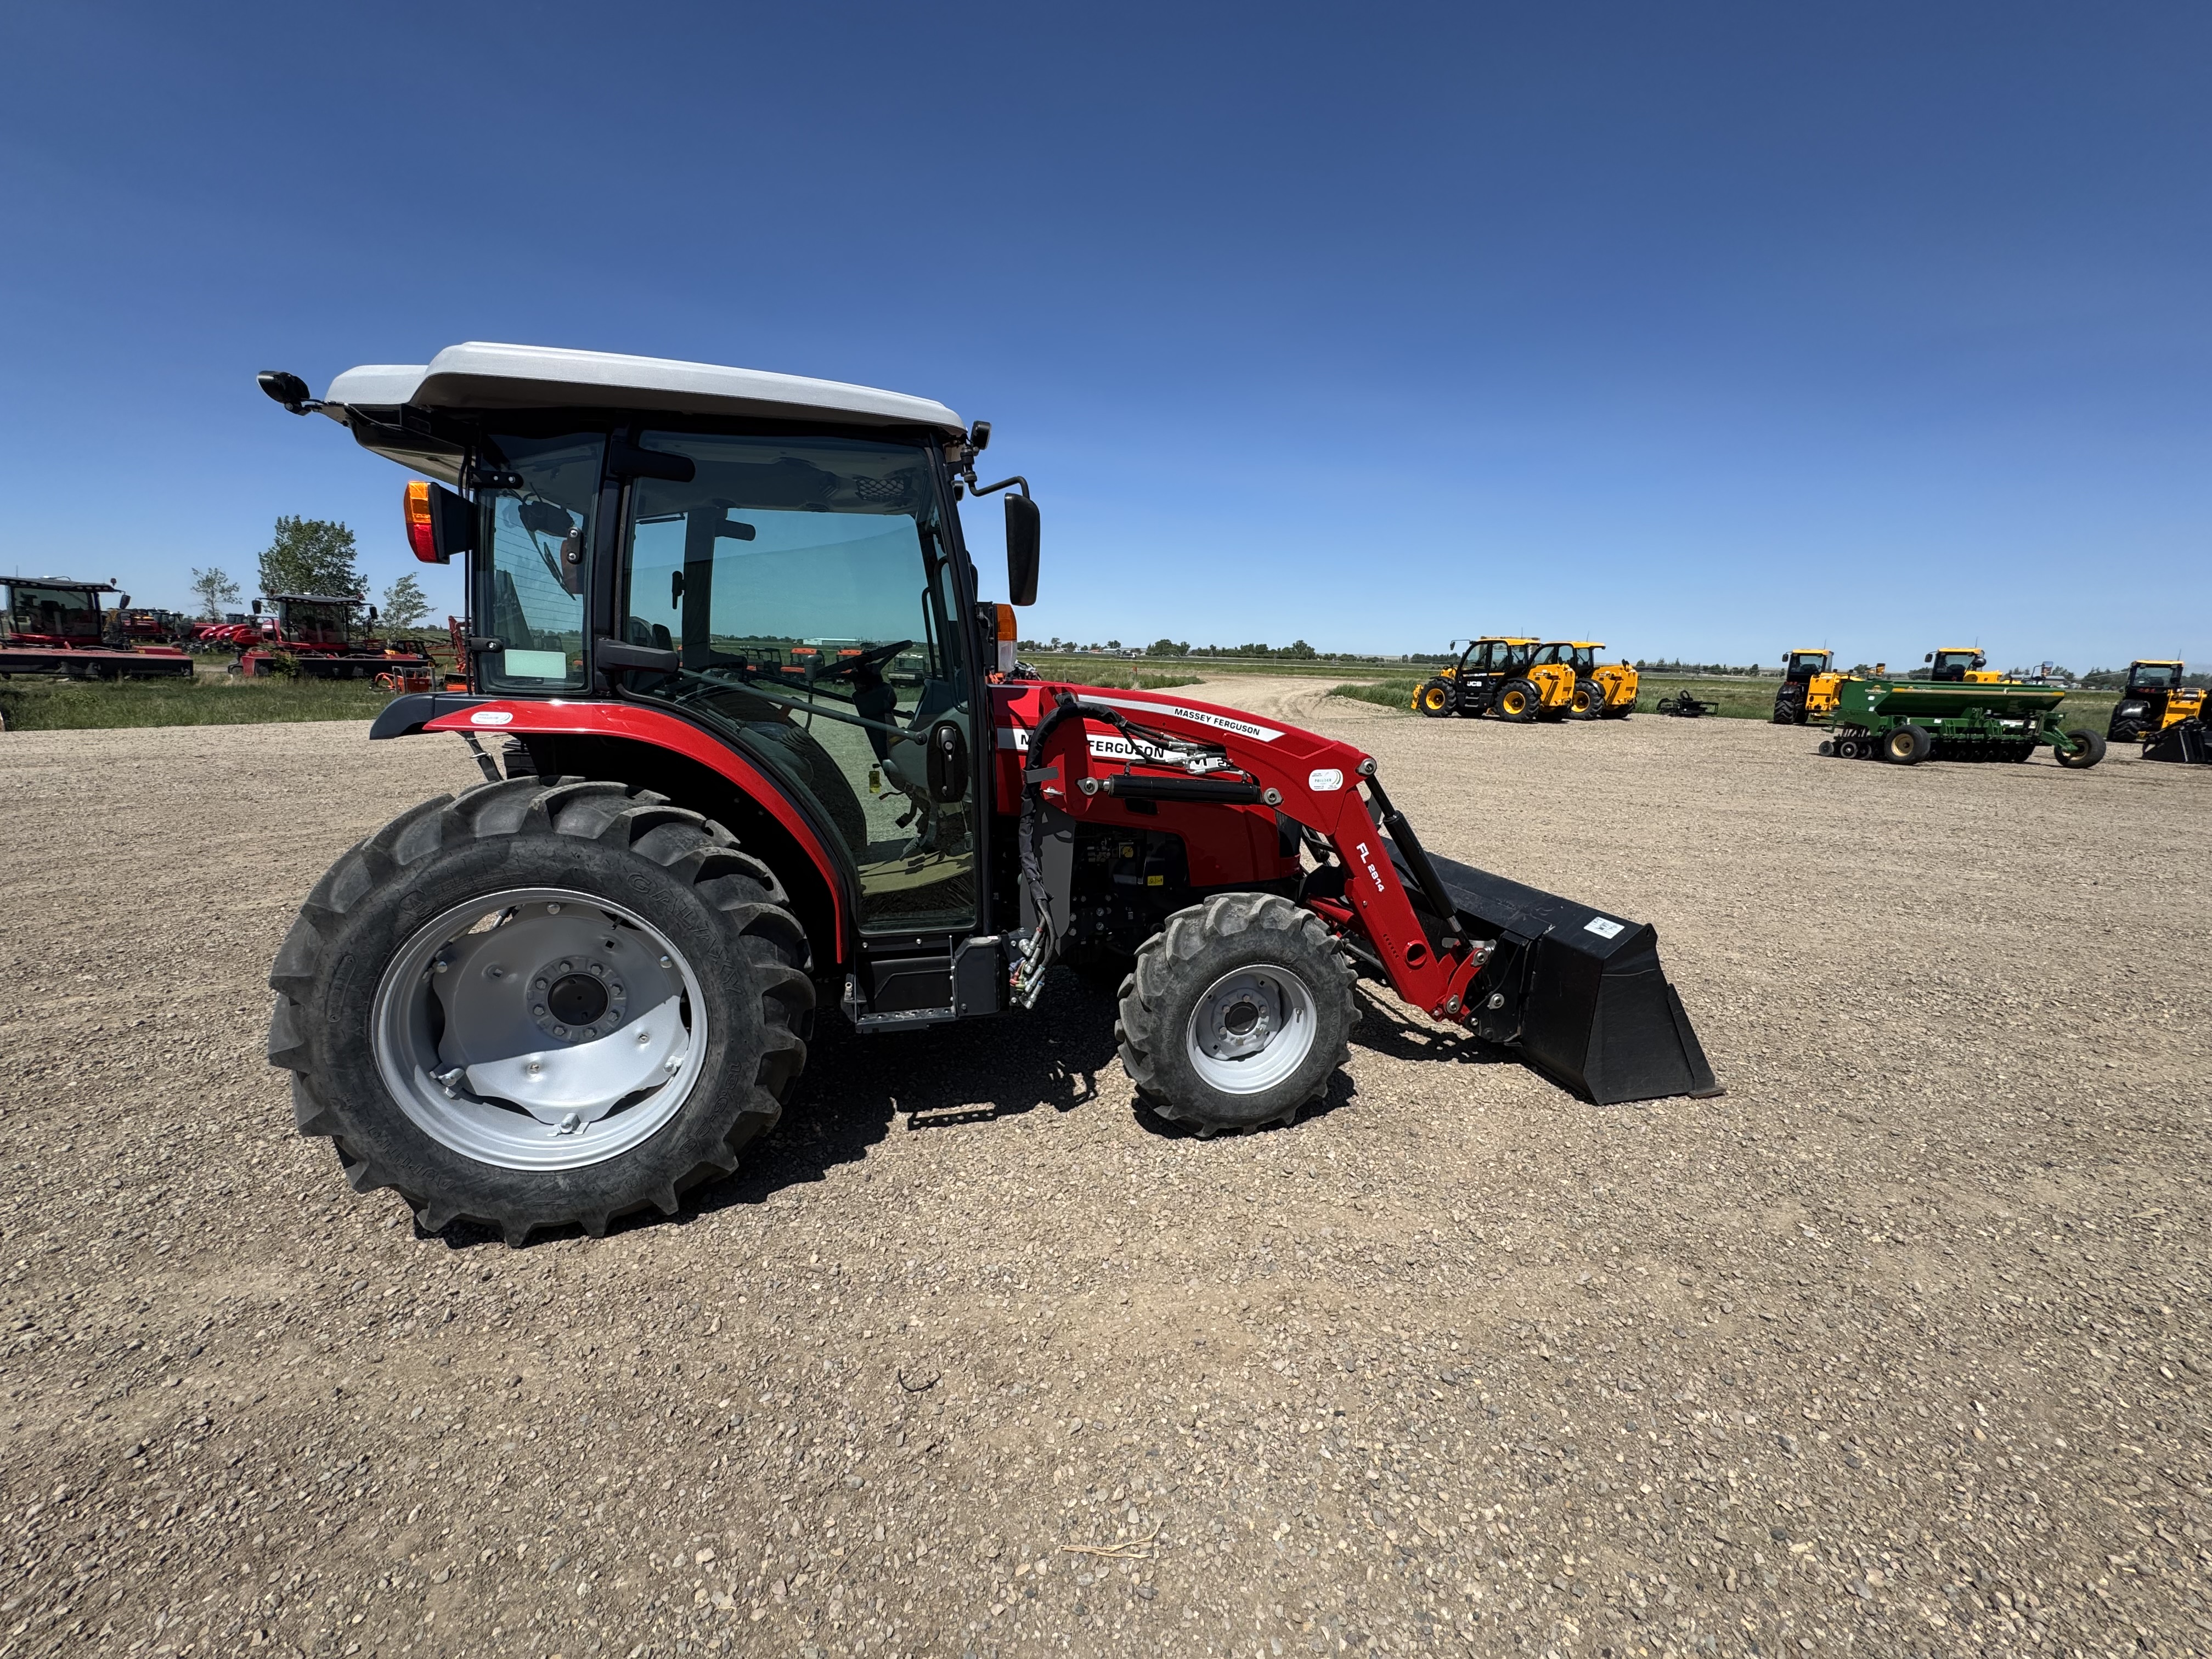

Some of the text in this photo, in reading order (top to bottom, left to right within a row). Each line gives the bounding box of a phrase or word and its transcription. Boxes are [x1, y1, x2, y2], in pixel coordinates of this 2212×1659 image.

[1174, 708, 1260, 736] MASSEY FERGUSON
[1356, 842, 1385, 893] FL 2814
[627, 872, 747, 996] GALAXY
[679, 1062, 742, 1154] 13.6-28
